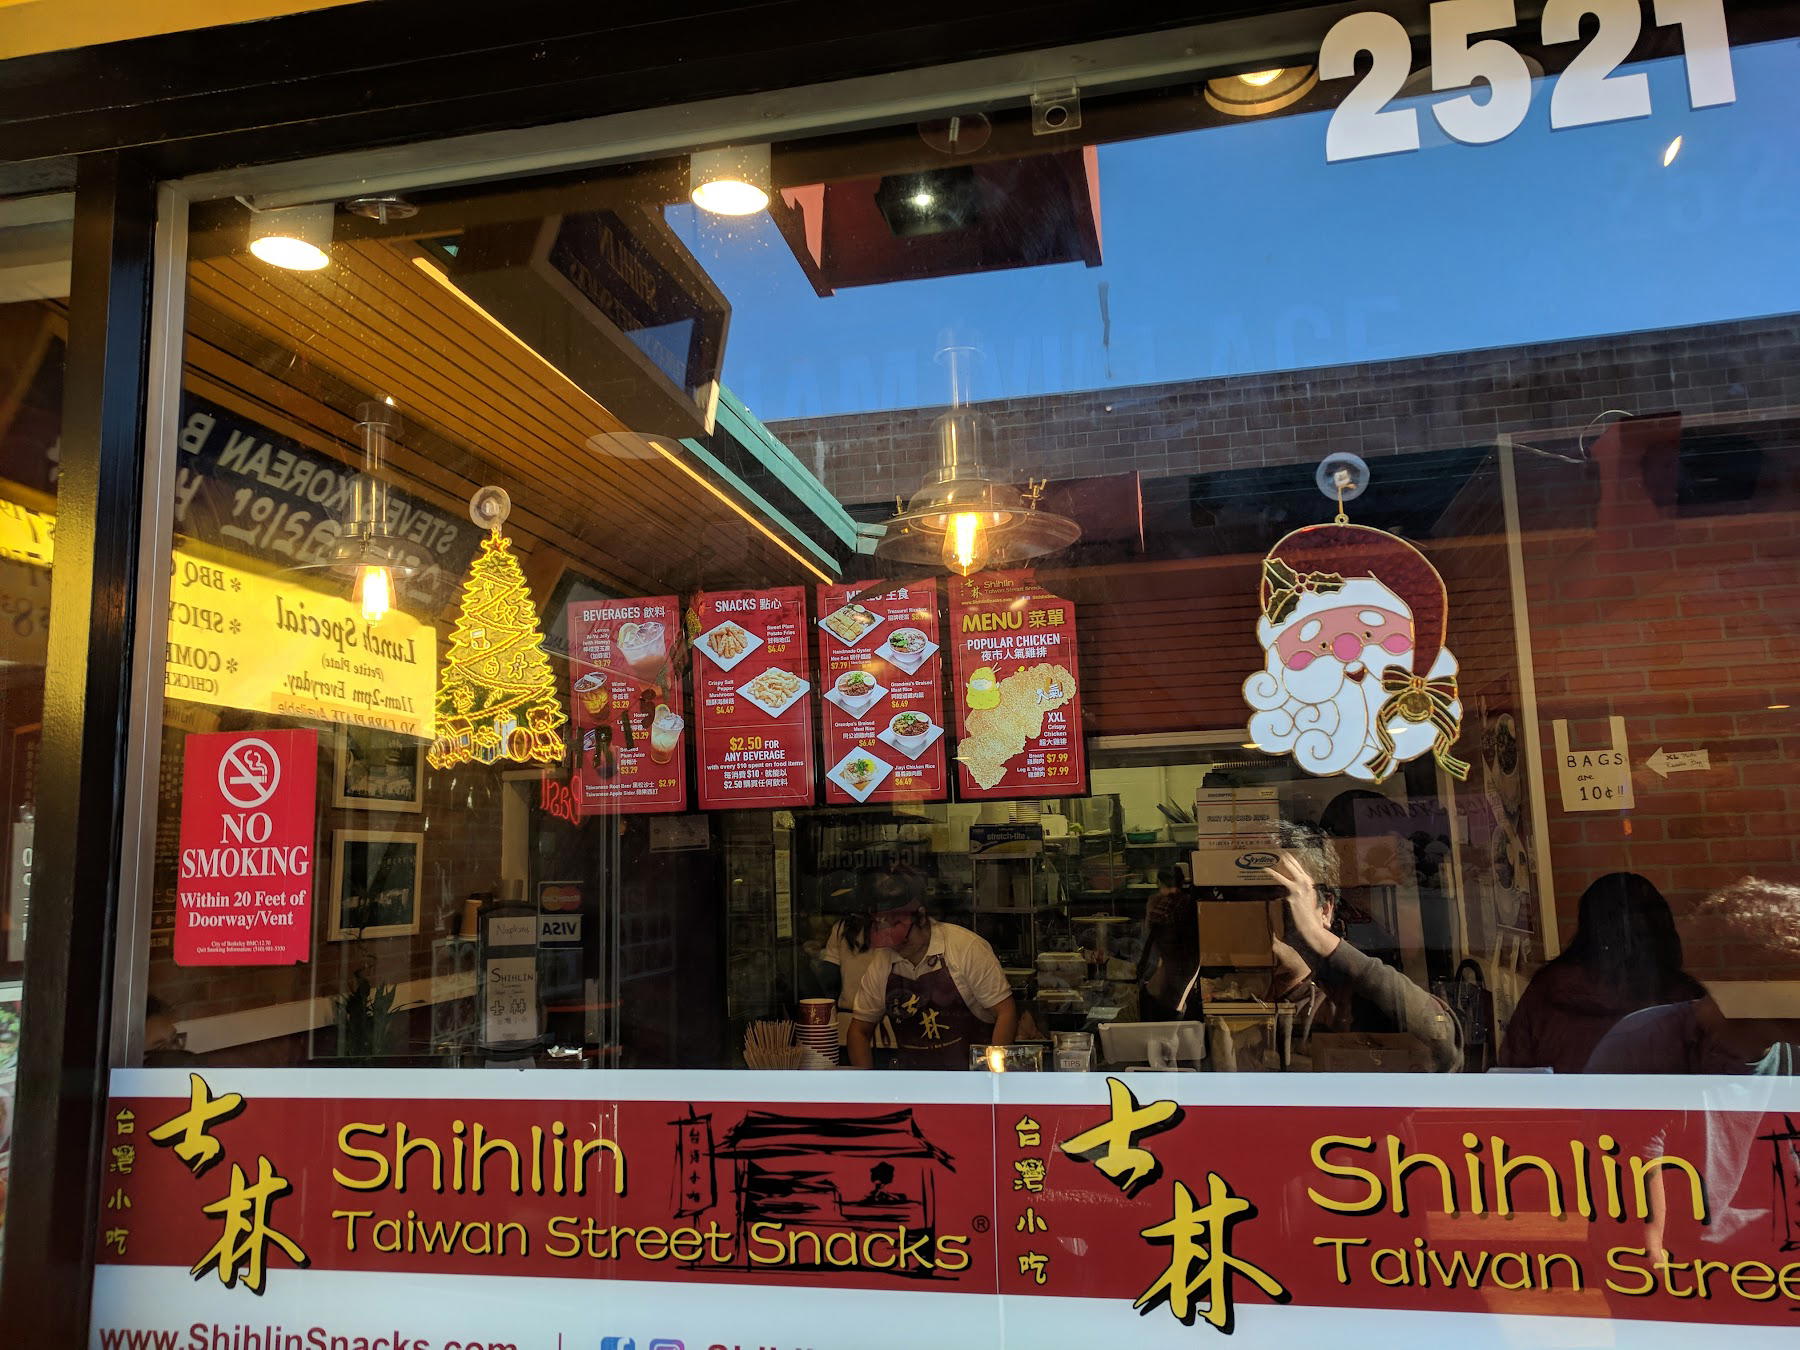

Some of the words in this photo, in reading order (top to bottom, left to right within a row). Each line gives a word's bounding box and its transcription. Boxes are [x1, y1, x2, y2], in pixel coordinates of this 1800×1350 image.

[1318, 0, 1736, 162] 2521
[984, 579, 1014, 589] Shihlin
[886, 587, 910, 601] 主食
[715, 599, 757, 613] SNACKS
[760, 598, 782, 611] 點心
[583, 607, 641, 622] BEVERAGES
[643, 606, 665, 619] 飲料
[962, 610, 1023, 633] MENU
[1028, 608, 1065, 629] 菜單
[967, 636, 1014, 650] POPULAR
[1016, 633, 1061, 648] CHICKEN
[767, 645, 786, 653] $4.49
[831, 661, 848, 670] $7.79
[612, 701, 630, 709] $3.29
[715, 706, 734, 714] $4.49
[891, 700, 909, 708] $6.49
[1047, 712, 1066, 723] XXL
[632, 731, 649, 740] $3.29
[729, 736, 762, 751] $2.50
[764, 740, 780, 749] FOR
[858, 739, 876, 747] $6.49
[724, 751, 742, 762] ANY
[743, 750, 786, 761] BEVERAGE
[1046, 753, 1068, 763] $7.99
[1567, 753, 1624, 768] BAGS
[620, 766, 638, 774] $3.29
[1047, 767, 1069, 777] $7.99
[658, 779, 676, 787] $2.99
[895, 778, 913, 786] $6.49
[1577, 774, 1595, 782] are
[219, 812, 273, 844] NO
[181, 845, 310, 879] SMOKING
[180, 892, 230, 908] Within
[233, 891, 252, 908] 20
[254, 890, 287, 907] Feet
[290, 890, 307, 906] of
[188, 910, 294, 930] Doorway/Vent
[331, 1119, 627, 1197] Shihlin
[147, 1072, 310, 1295] 士林
[1307, 1132, 1710, 1222] Shihlin
[1060, 1077, 1291, 1335] 士林
[331, 1208, 529, 1258] Taiwan
[544, 1214, 734, 1263] Street
[748, 1220, 971, 1272] Snacks
[1312, 1236, 1584, 1293] Taiwan
